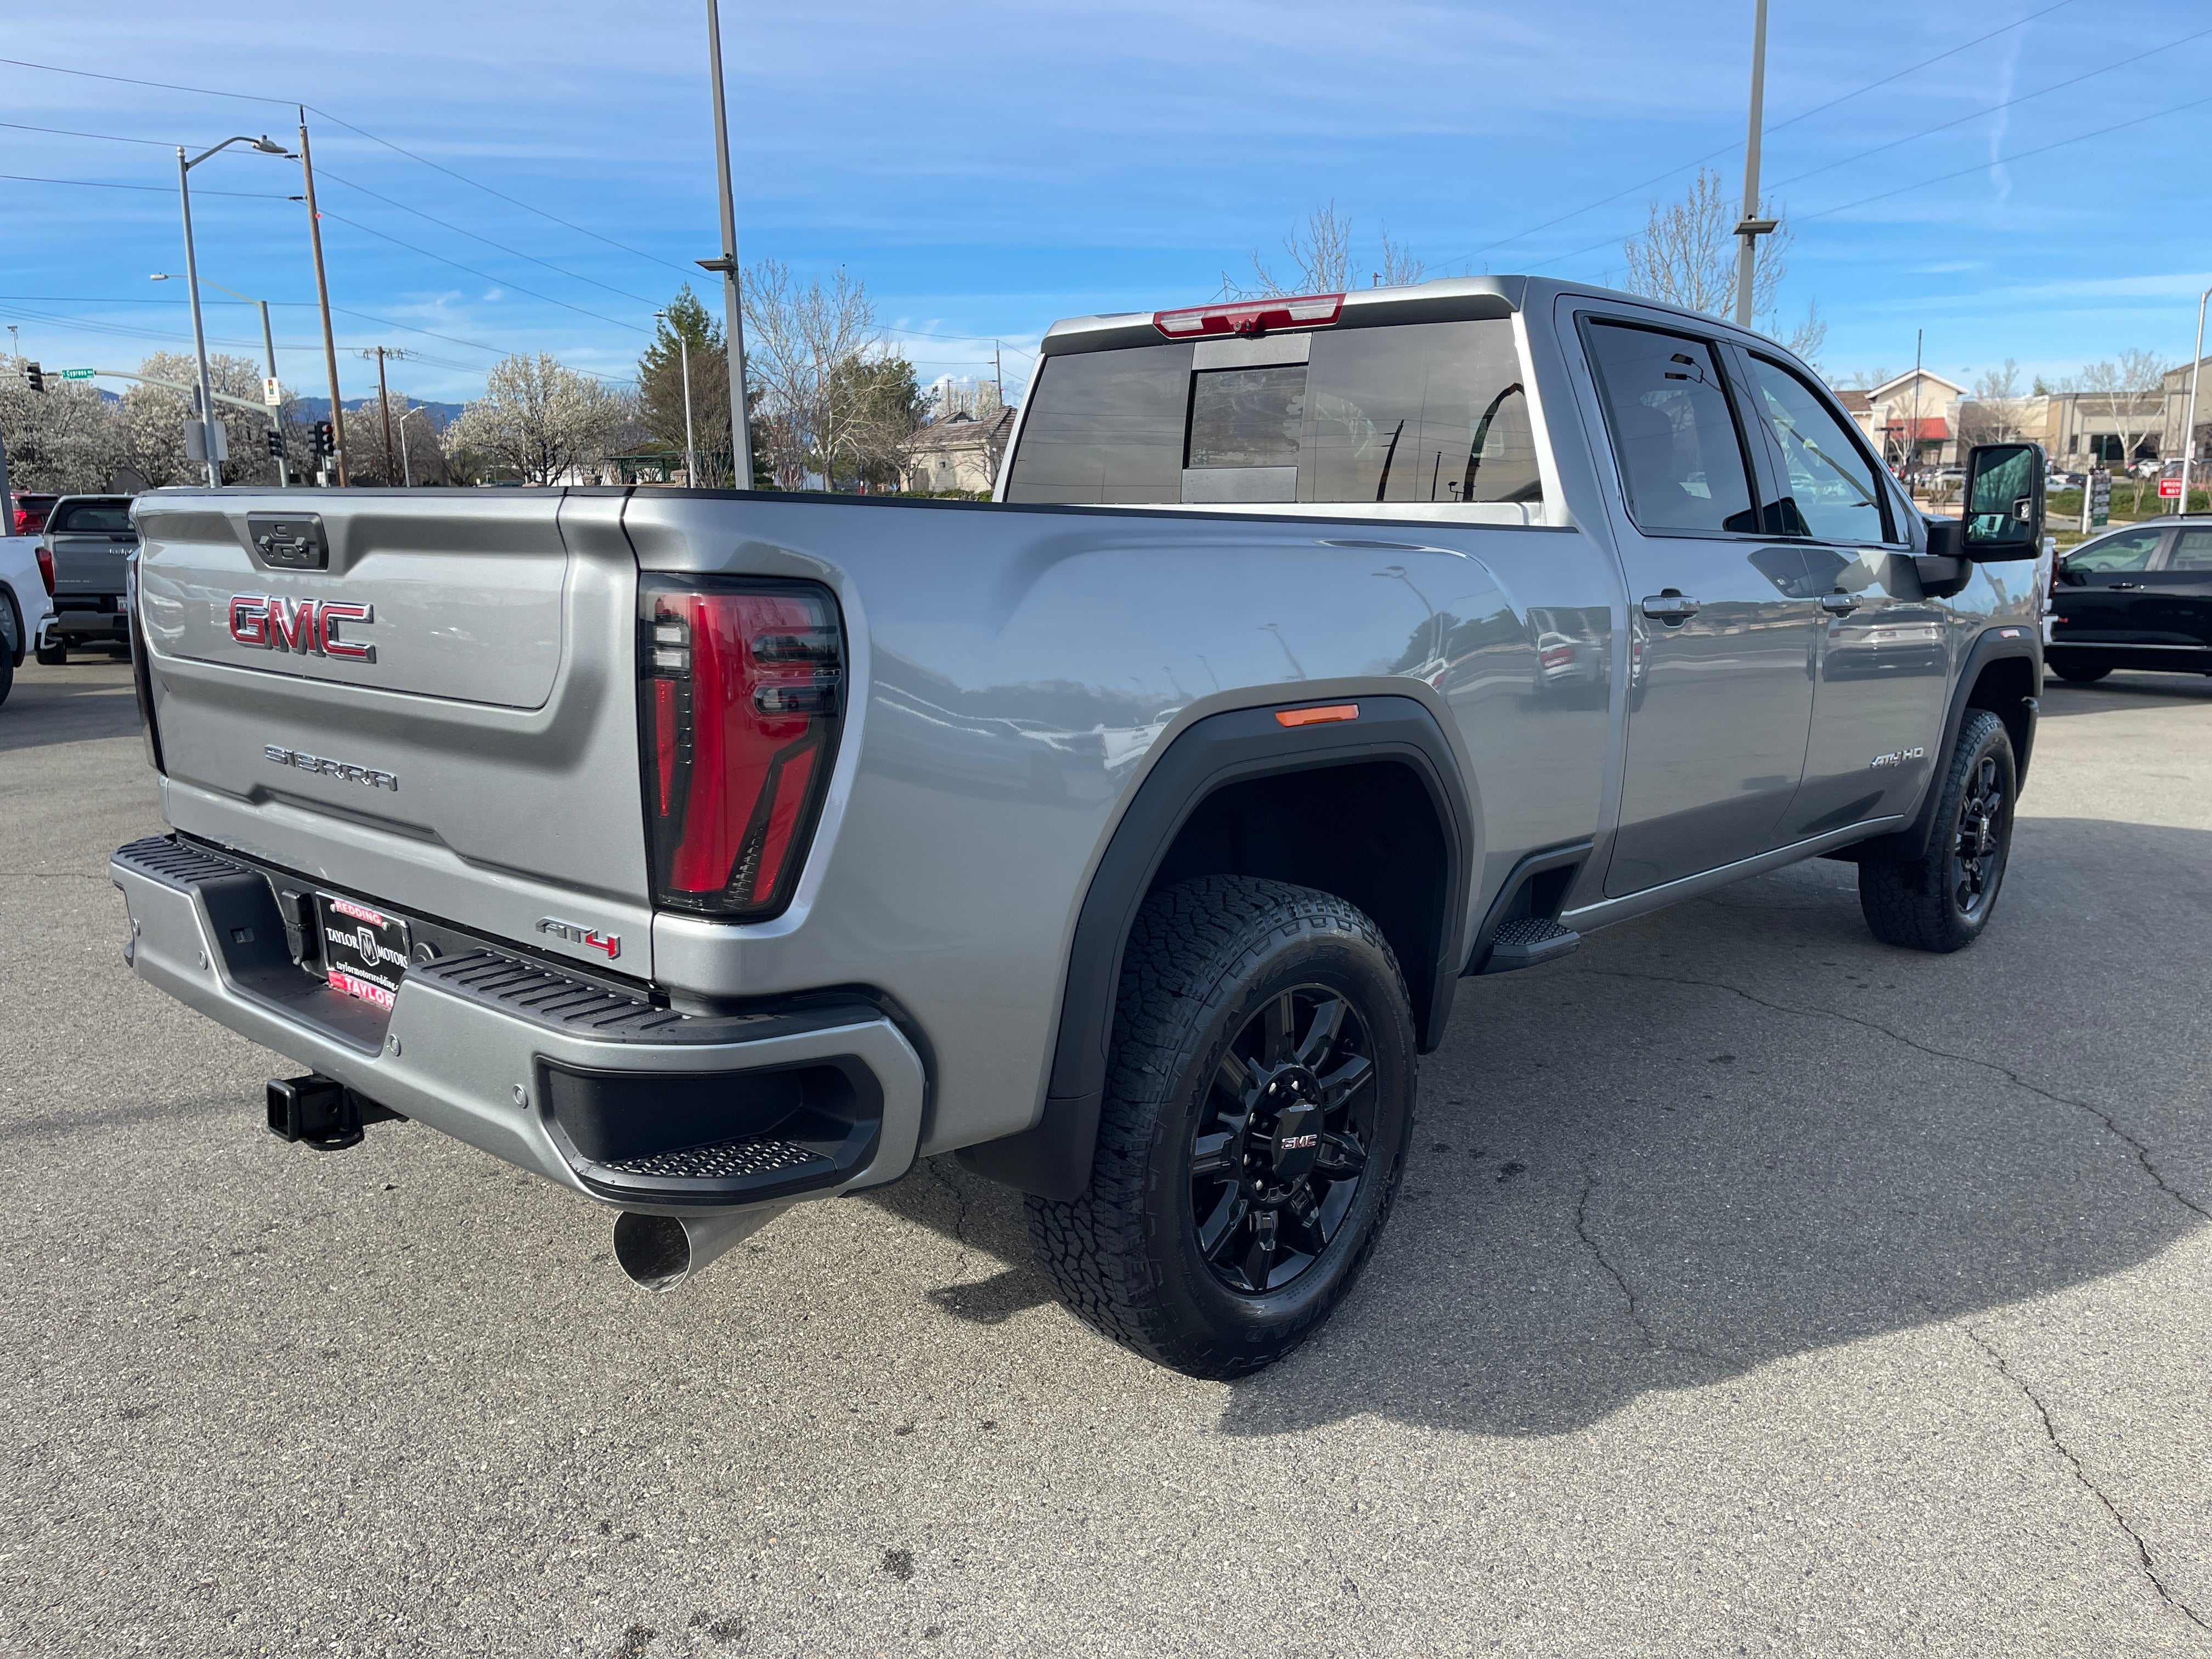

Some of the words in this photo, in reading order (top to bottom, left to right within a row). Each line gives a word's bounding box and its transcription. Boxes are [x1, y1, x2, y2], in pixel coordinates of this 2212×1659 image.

[229, 592, 376, 664] GMC
[264, 744, 398, 791] SIERRA
[1902, 747, 1924, 761] HD
[335, 900, 381, 925] REDDING
[325, 927, 360, 950] TAYLOR
[377, 944, 409, 969] MOTORS
[535, 915, 622, 961] AT4
[344, 977, 394, 1008] TAYLOR
[1281, 1133, 1318, 1150] GMC
